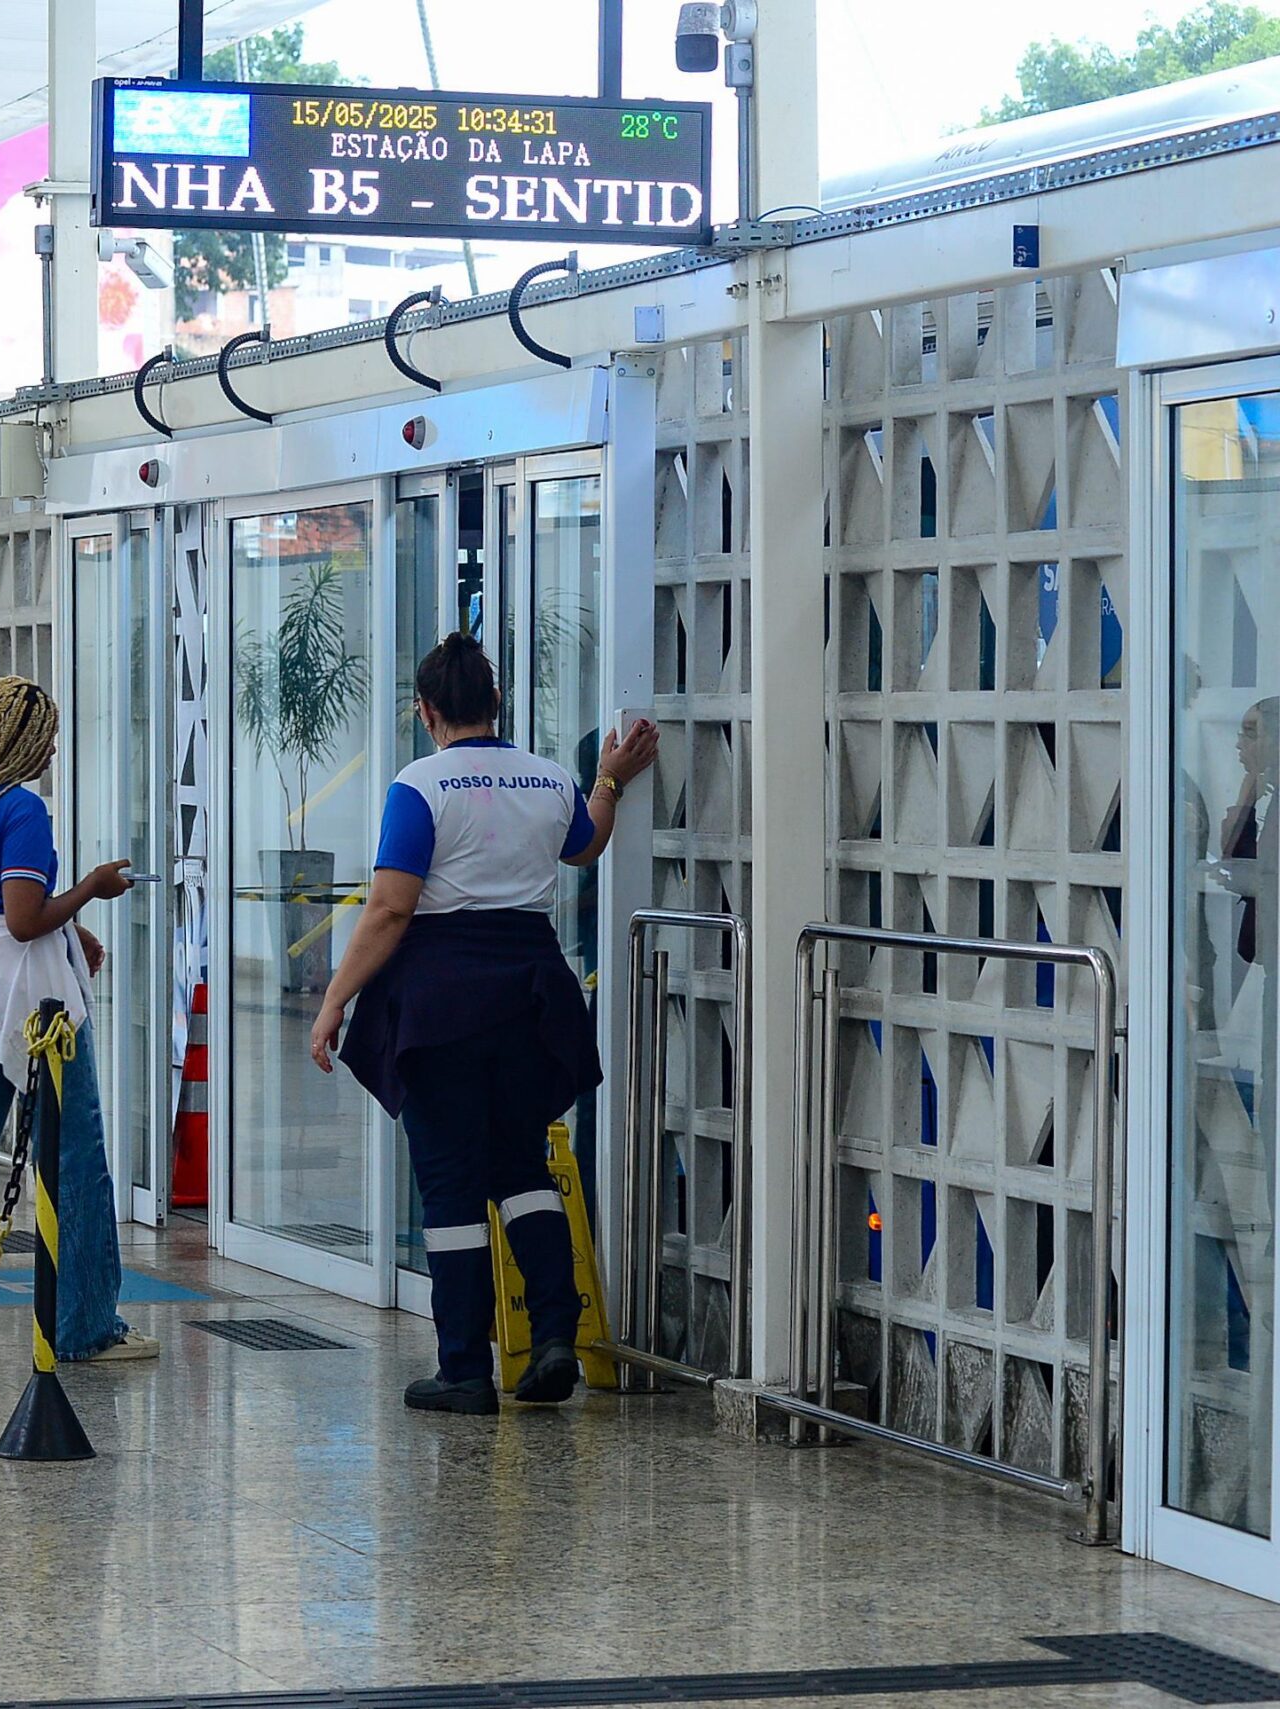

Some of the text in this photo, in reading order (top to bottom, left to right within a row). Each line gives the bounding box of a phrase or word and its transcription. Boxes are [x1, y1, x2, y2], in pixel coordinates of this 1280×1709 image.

[292, 100, 678, 140] 15/05/2025 10:34:31 28°C
[331, 131, 591, 166] ESTAÇÃO DA LAPA
[308, 168, 380, 216] B5
[465, 174, 703, 228] SENTID
[438, 775, 565, 793] POSSO AJUDAR?
